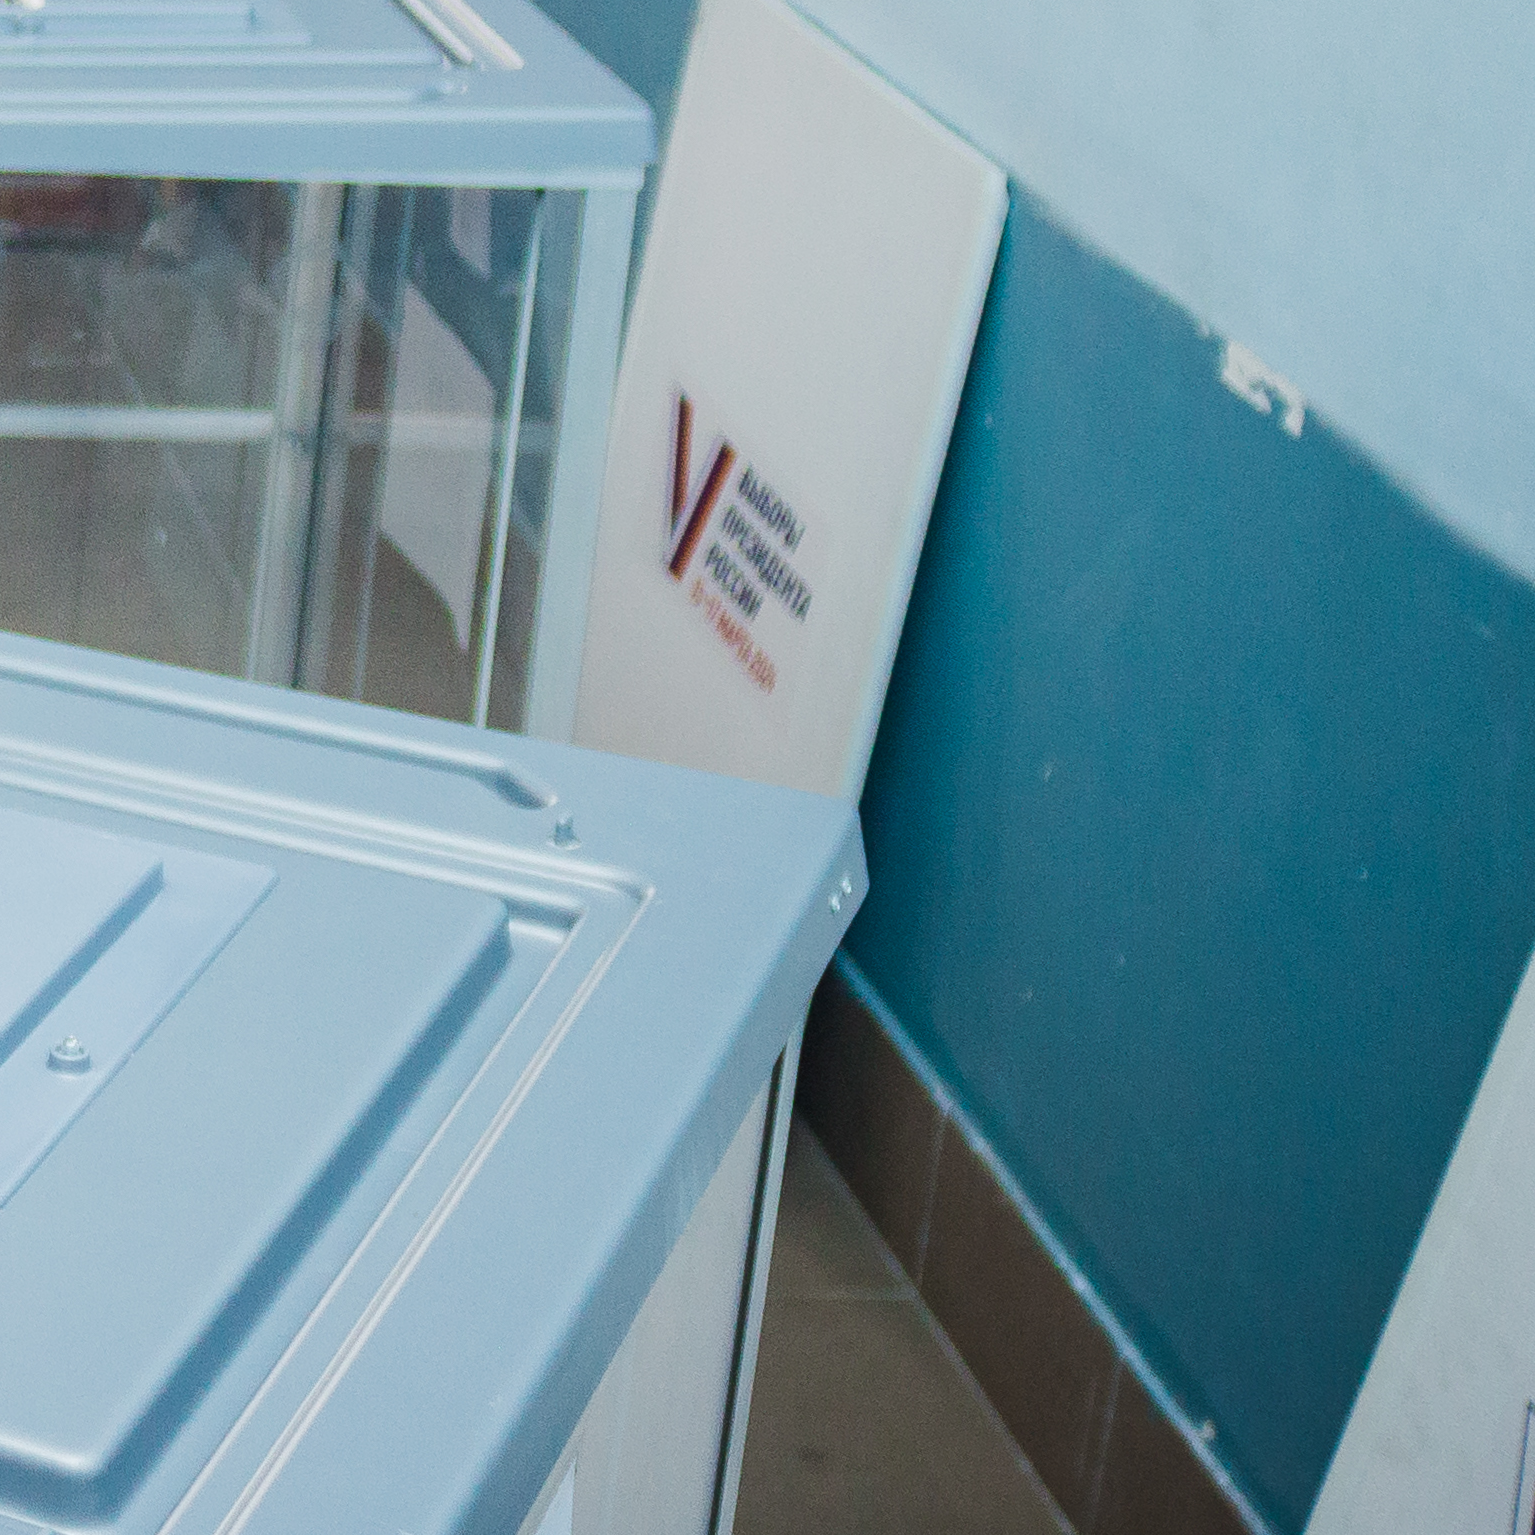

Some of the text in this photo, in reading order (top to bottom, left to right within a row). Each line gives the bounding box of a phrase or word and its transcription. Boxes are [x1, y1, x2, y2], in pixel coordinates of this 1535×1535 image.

[738, 464, 806, 555] ВЫБОРЫ
[705, 541, 763, 622] РОССИИ
[721, 505, 812, 624] ПРЕЗИДЕНТА
